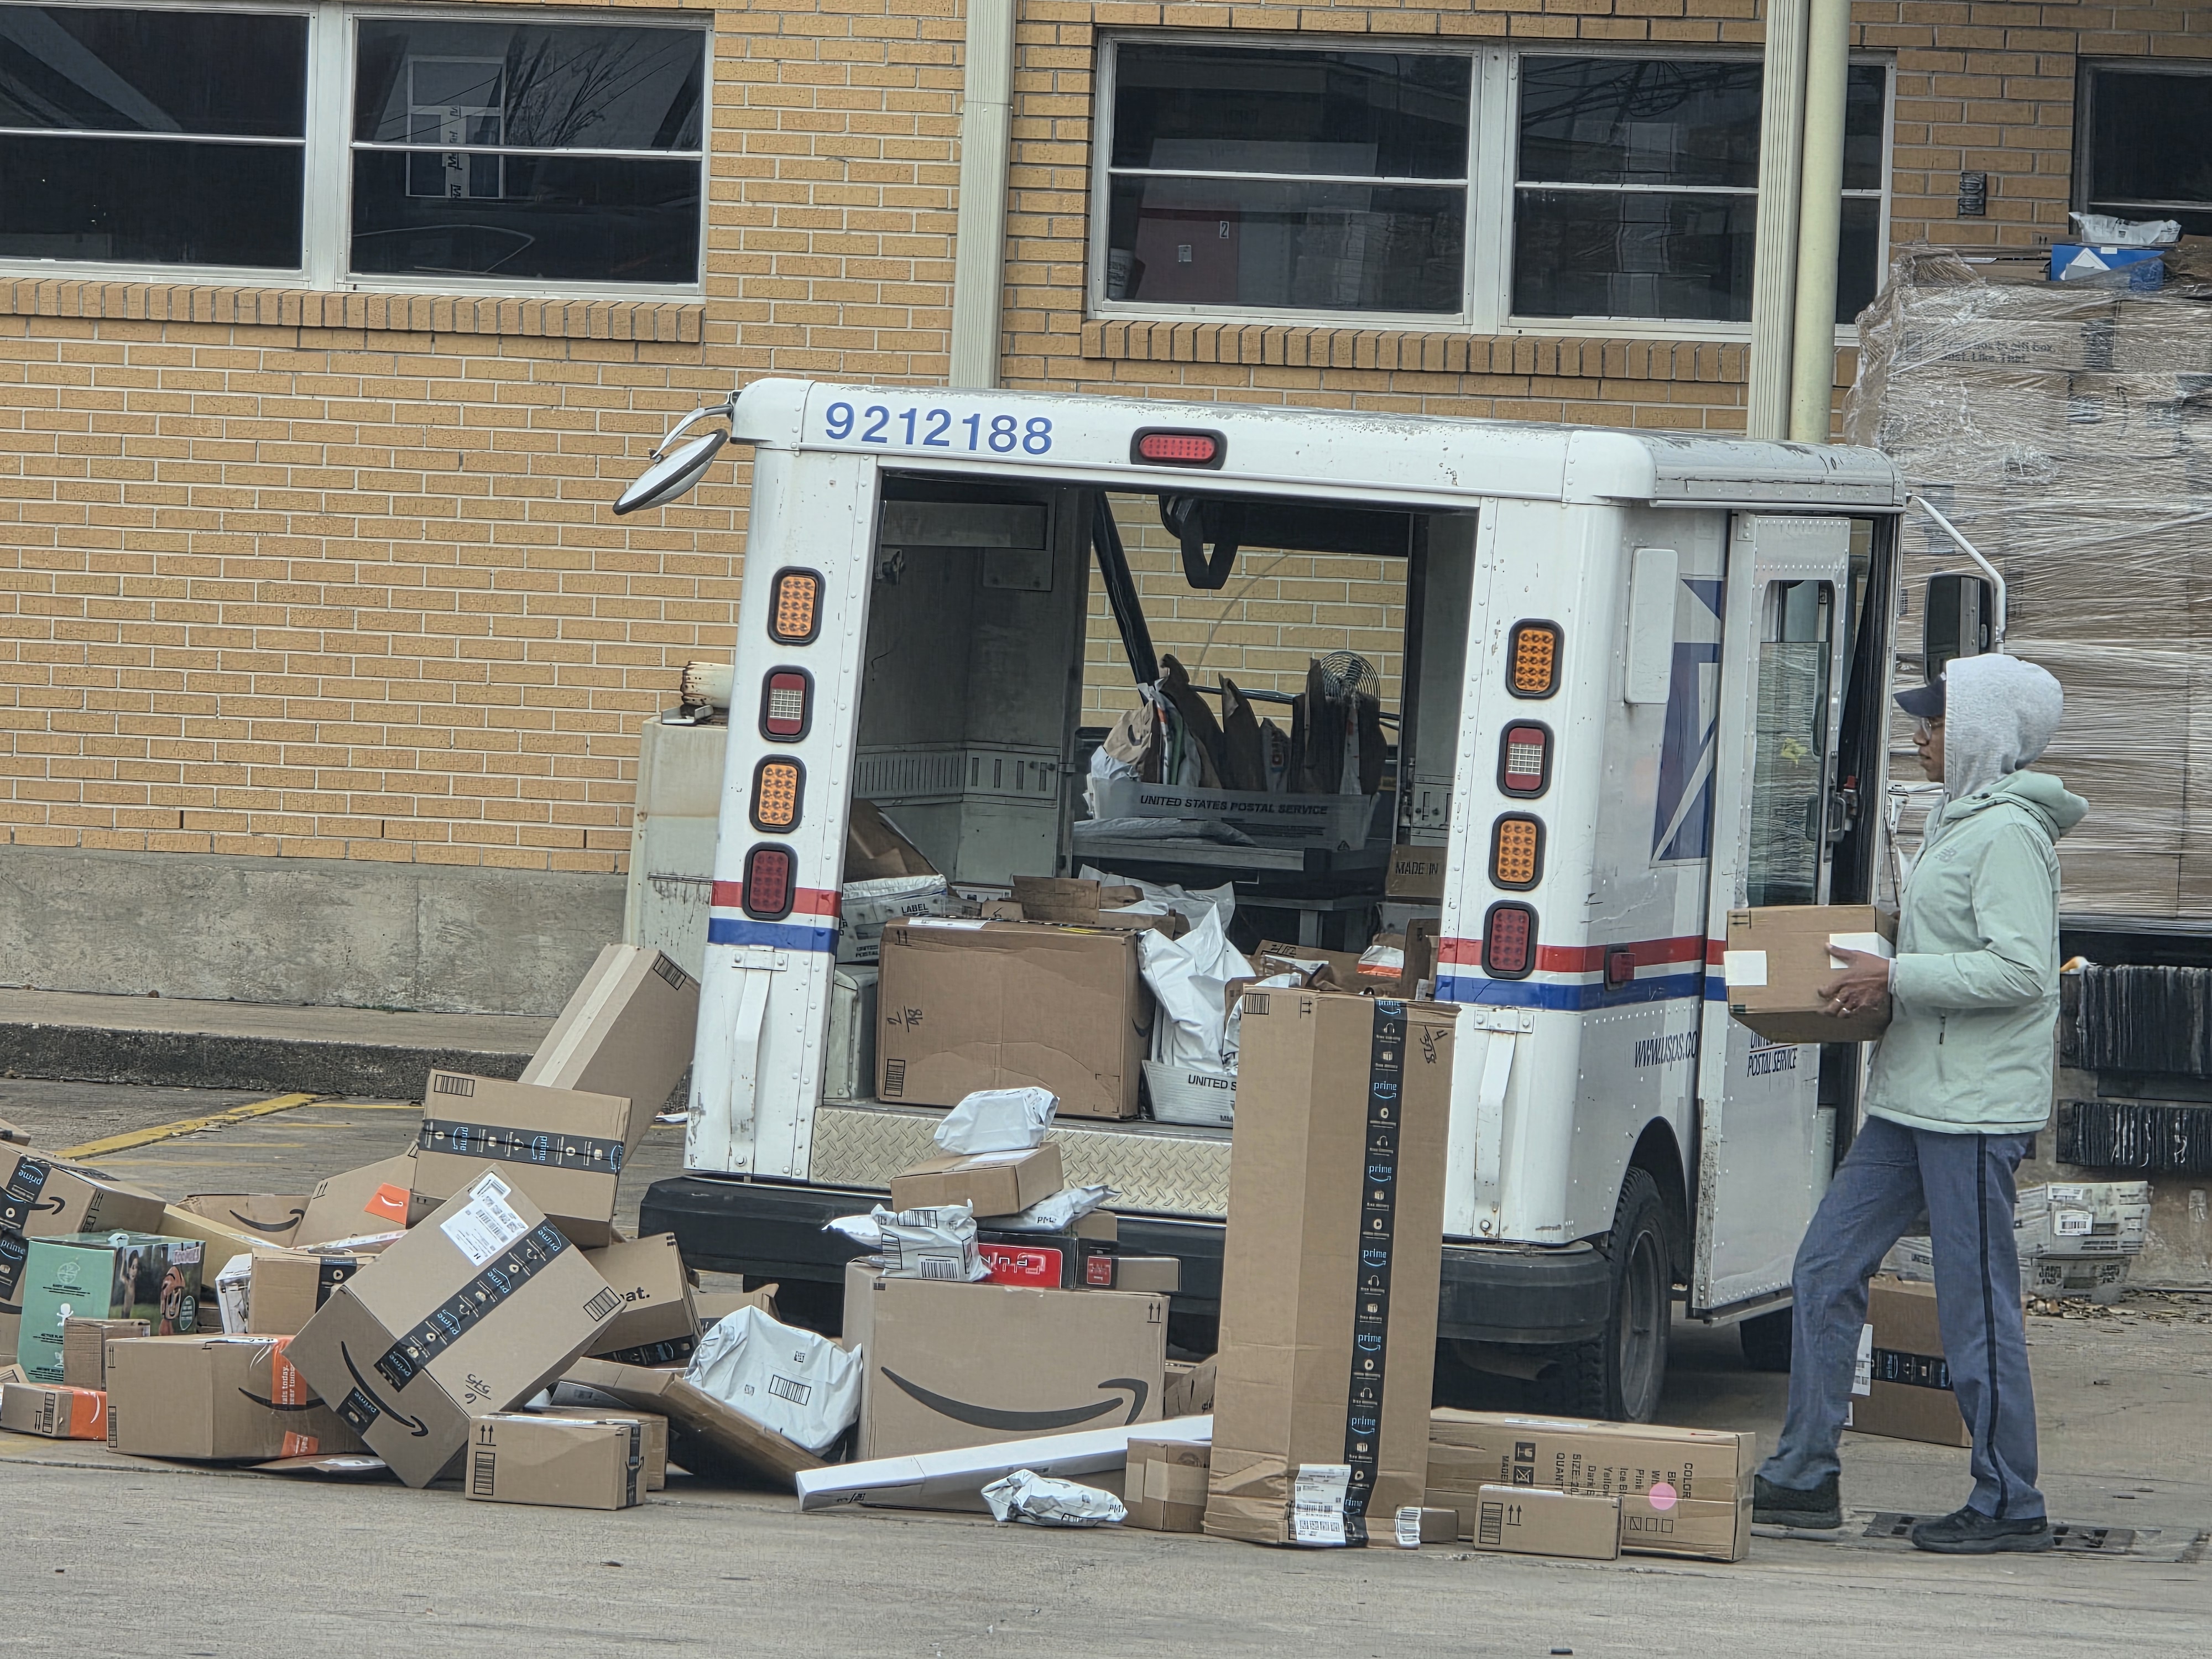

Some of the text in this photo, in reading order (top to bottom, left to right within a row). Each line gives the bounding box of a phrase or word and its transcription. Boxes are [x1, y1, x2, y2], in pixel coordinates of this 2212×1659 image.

[826, 401, 1052, 455] 9212188
[1141, 795, 1327, 815] UNITED STATES POSTAL SERVICE
[901, 904, 929, 913] LABEL
[1635, 1031, 1698, 1071] www.usps.co
[1747, 1048, 1797, 1077] POSTAL SERVICE
[1188, 1074, 1228, 1088] UNITED
[1374, 1081, 1397, 1091] prime
[18, 1168, 43, 1185] prime
[1369, 1165, 1392, 1175] prime
[1, 1239, 26, 1255] prime
[538, 1229, 559, 1252] prime
[1363, 1248, 1386, 1259] prime
[487, 1271, 510, 1293] prime
[437, 1313, 460, 1335] prime
[1358, 1333, 1381, 1343] prime
[389, 1354, 411, 1376] prime
[354, 1391, 377, 1414] prime
[1352, 1416, 1375, 1427] prime
[1345, 1497, 1362, 1507] rime
